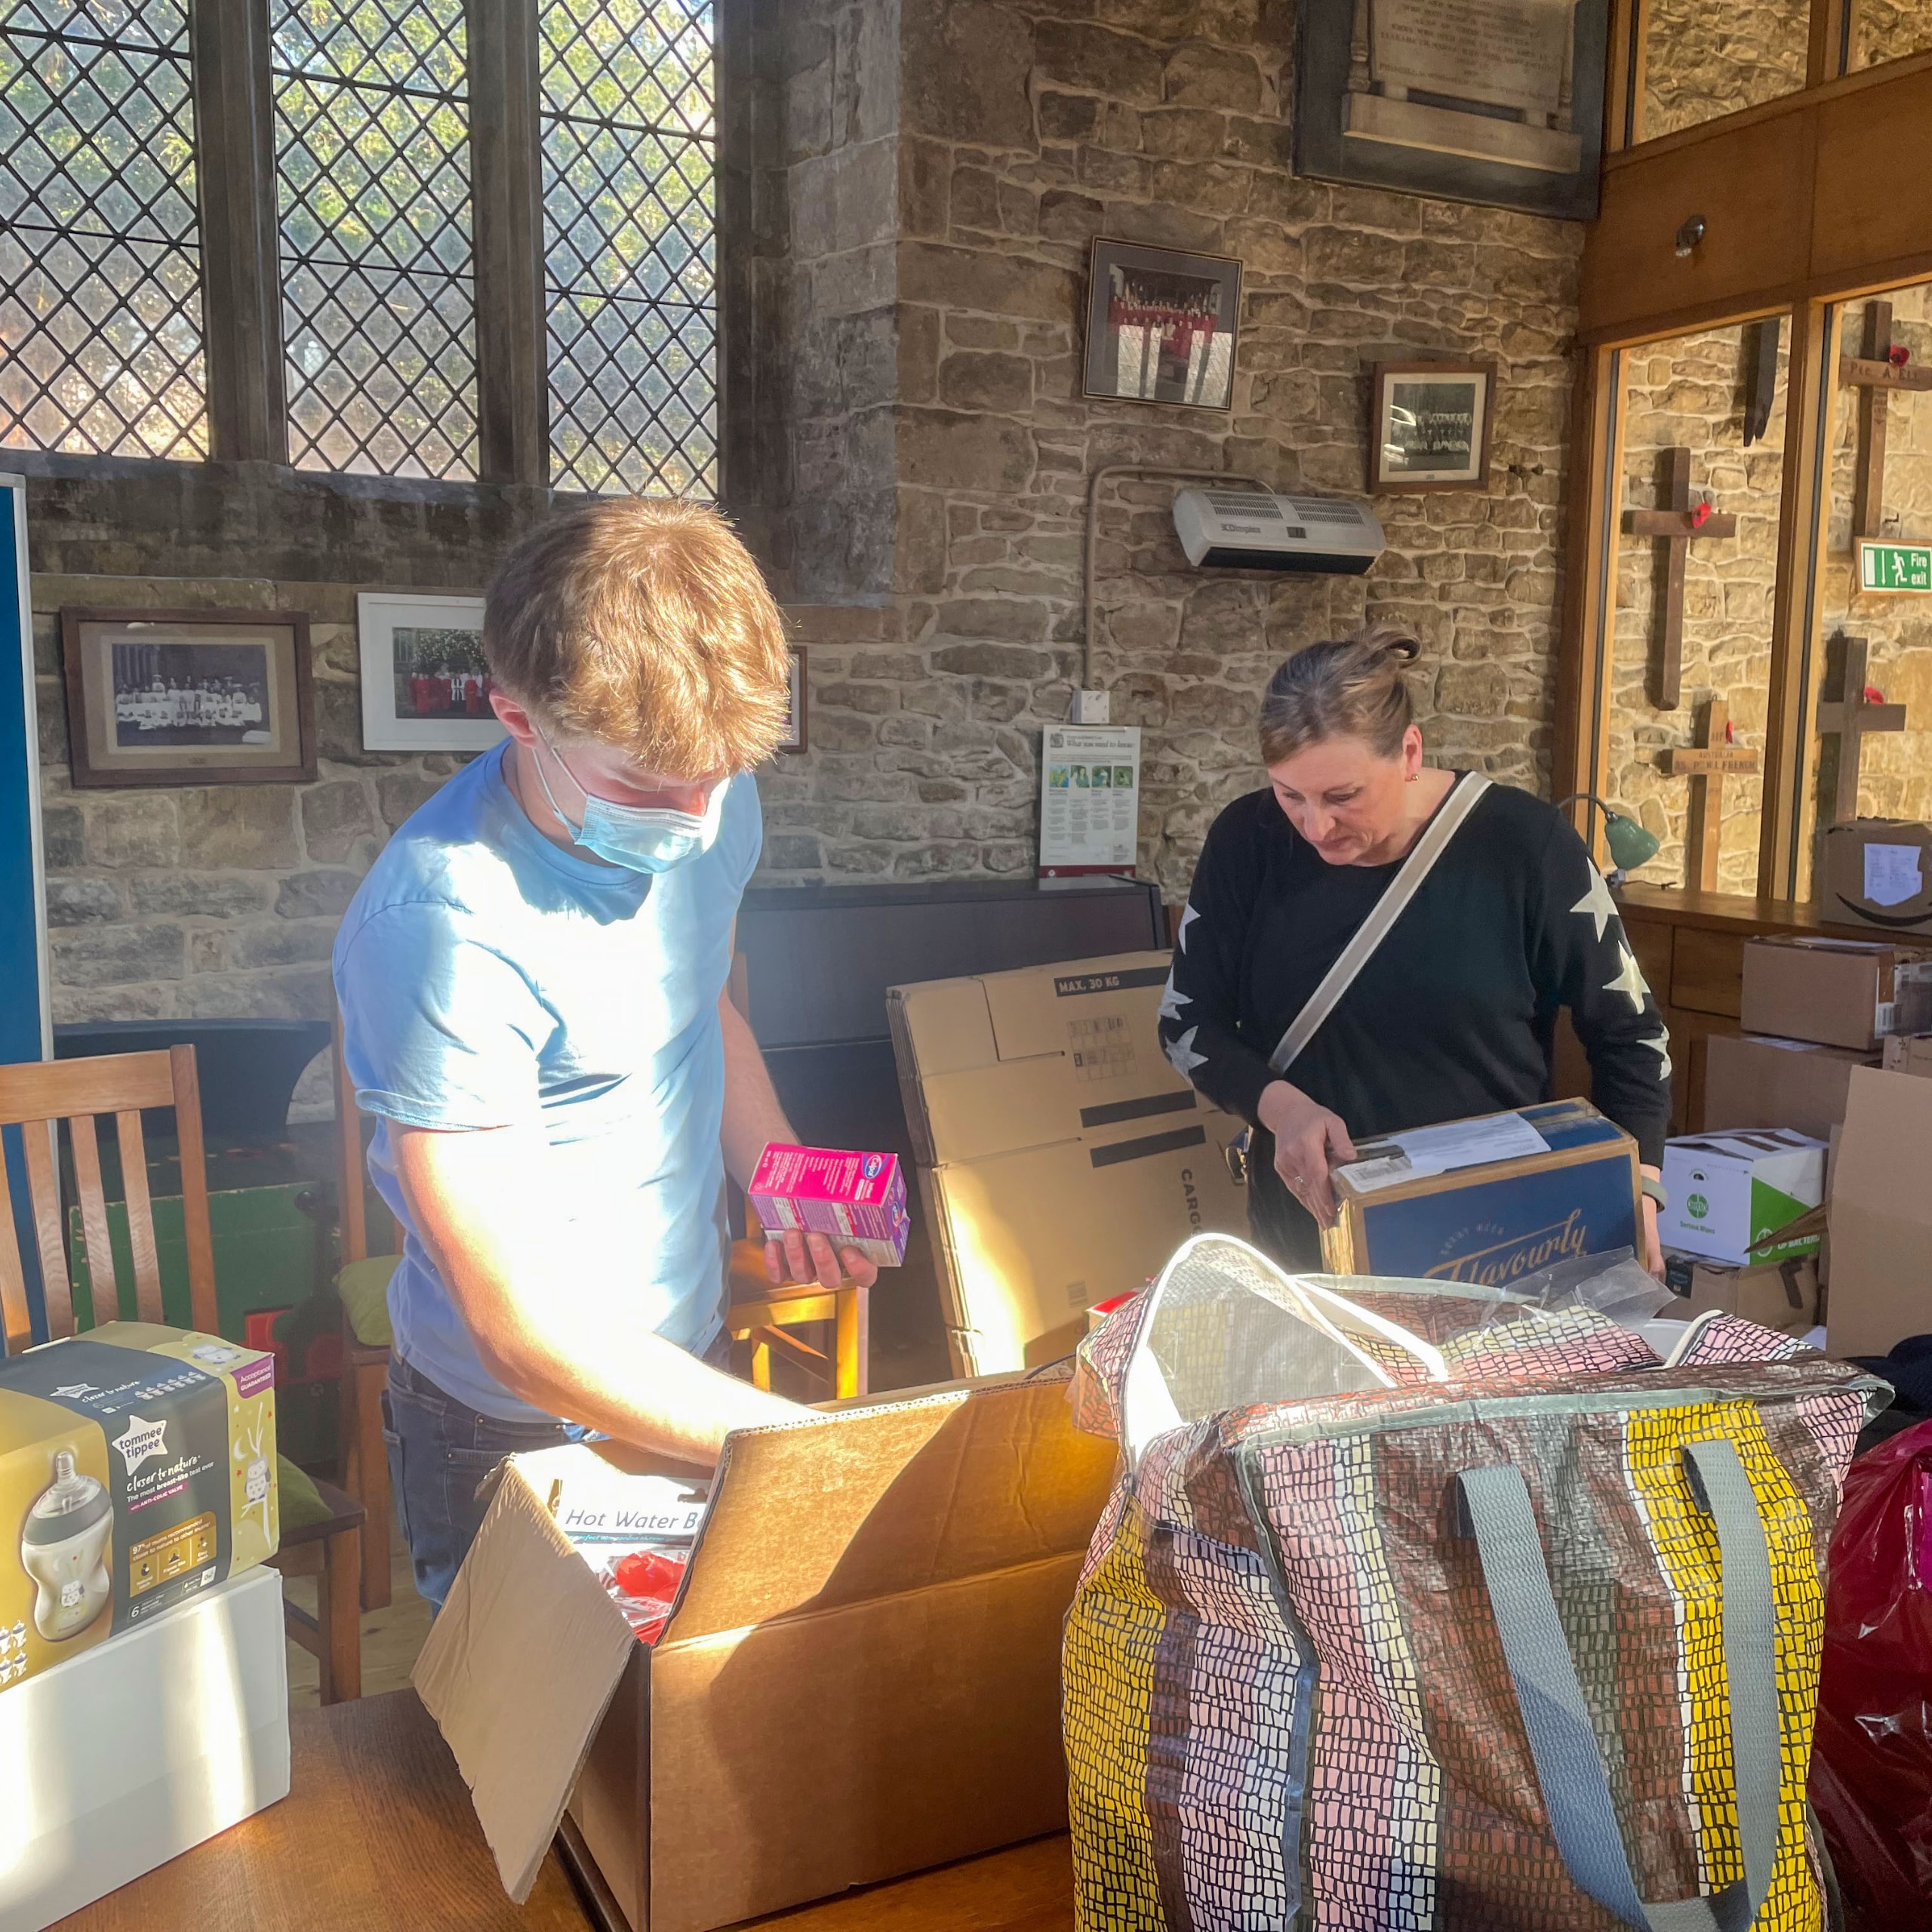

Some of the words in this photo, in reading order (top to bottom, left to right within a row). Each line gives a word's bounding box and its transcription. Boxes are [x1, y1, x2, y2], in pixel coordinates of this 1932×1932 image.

[1911, 552, 1927, 568] Fire
[1911, 571, 1927, 586] exit
[1059, 980, 1087, 992] MAX.
[1089, 979, 1103, 989] 30
[1105, 976, 1120, 987] KG
[241, 1373, 271, 1391] GUARANTEED
[119, 1427, 162, 1449] tommee
[126, 1438, 160, 1458] tippee
[127, 1472, 157, 1491] closer
[127, 1492, 139, 1503] The
[140, 1486, 155, 1497] most
[156, 1472, 189, 1491] breast-like
[189, 1467, 201, 1476] teat
[202, 1461, 214, 1471] ever
[565, 1509, 606, 1526] Hot
[615, 1511, 679, 1529] Water
[131, 1606, 140, 1618] 6
